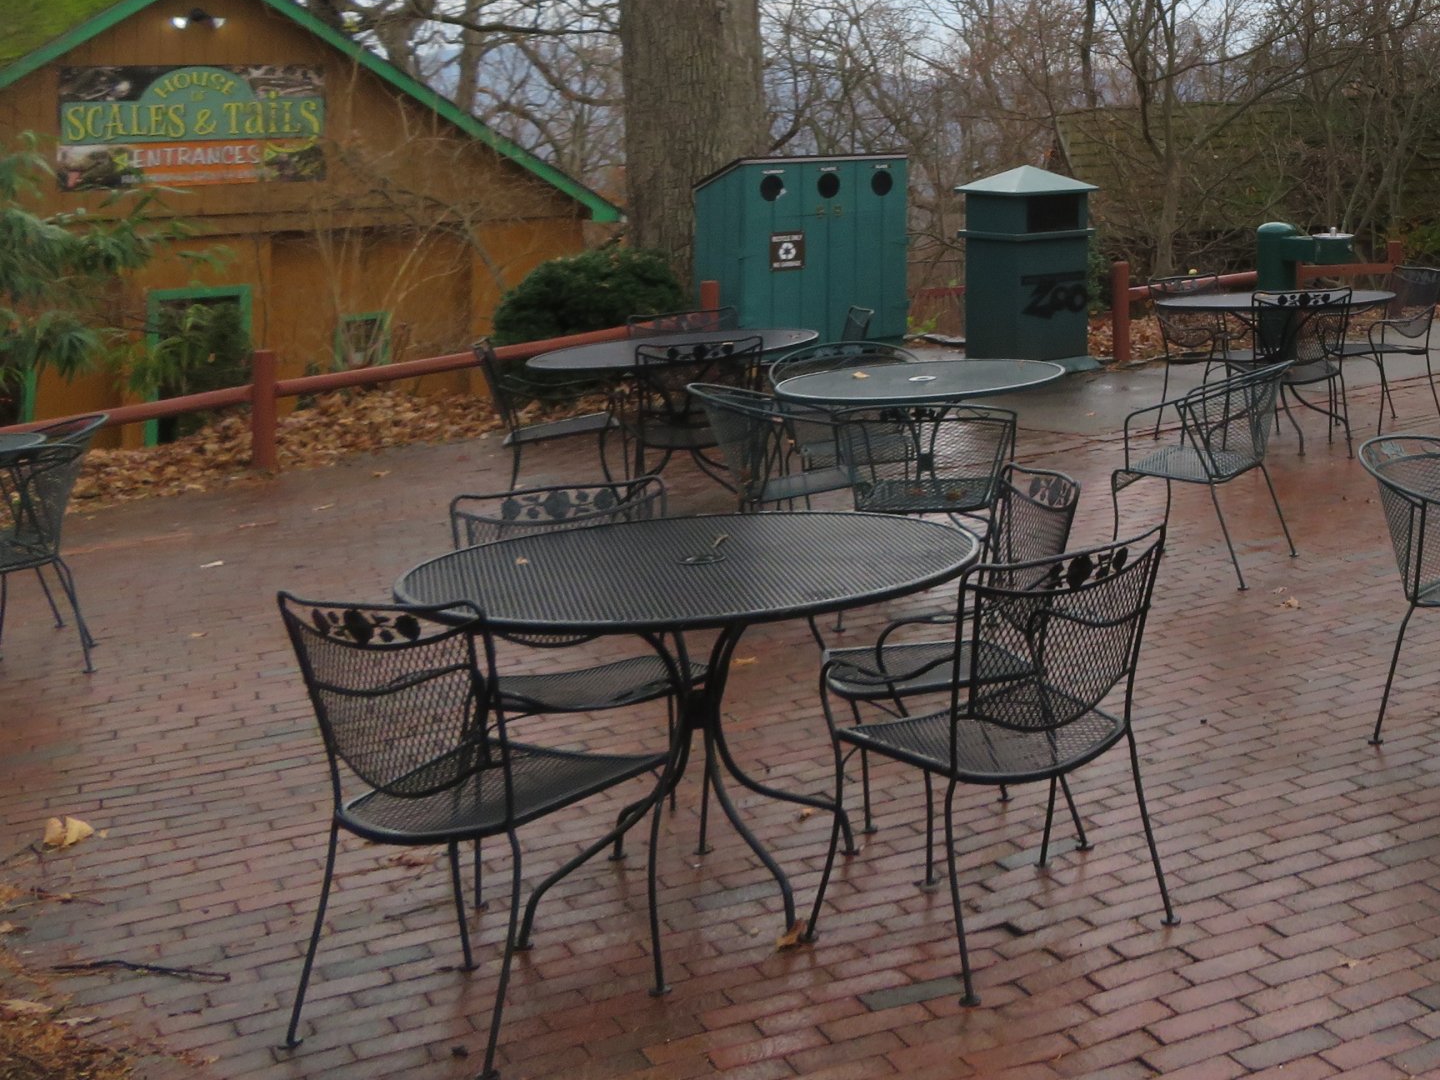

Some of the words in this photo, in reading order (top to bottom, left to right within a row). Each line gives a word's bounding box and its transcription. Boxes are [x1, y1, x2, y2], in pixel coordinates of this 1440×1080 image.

[154, 71, 238, 99] HOUSE
[65, 102, 187, 141] SCALES
[192, 108, 218, 136] &
[131, 144, 262, 169] ENTRANCES
